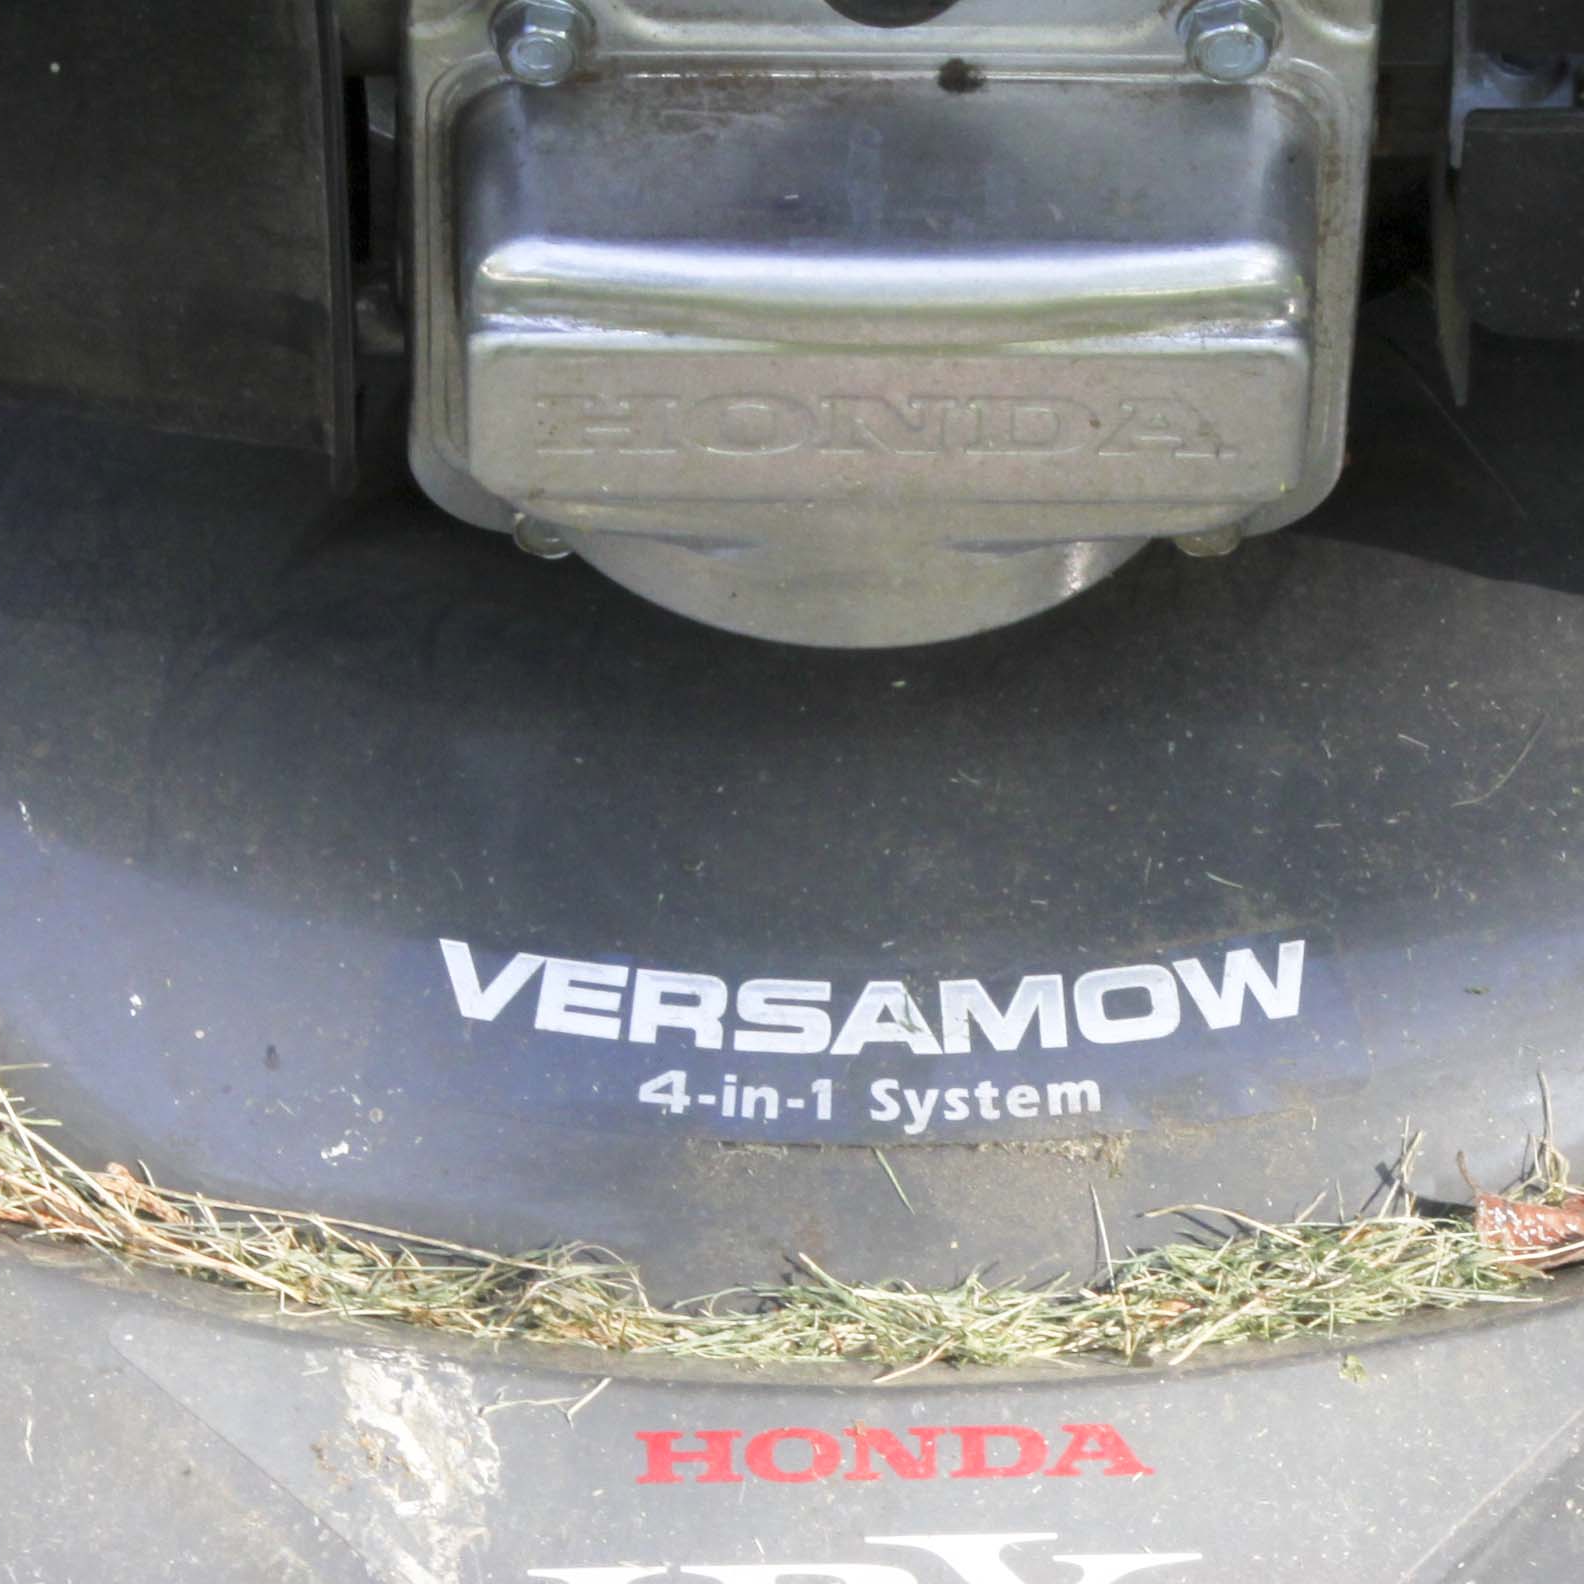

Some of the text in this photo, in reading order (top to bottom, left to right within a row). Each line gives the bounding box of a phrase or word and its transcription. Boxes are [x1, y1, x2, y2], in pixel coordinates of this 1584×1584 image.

[534, 393, 1237, 458] HONDA
[439, 937, 1306, 1056] VERSAMOW
[637, 1070, 1102, 1136] 4-in-1 System
[633, 1423, 1156, 1485] HONDA
